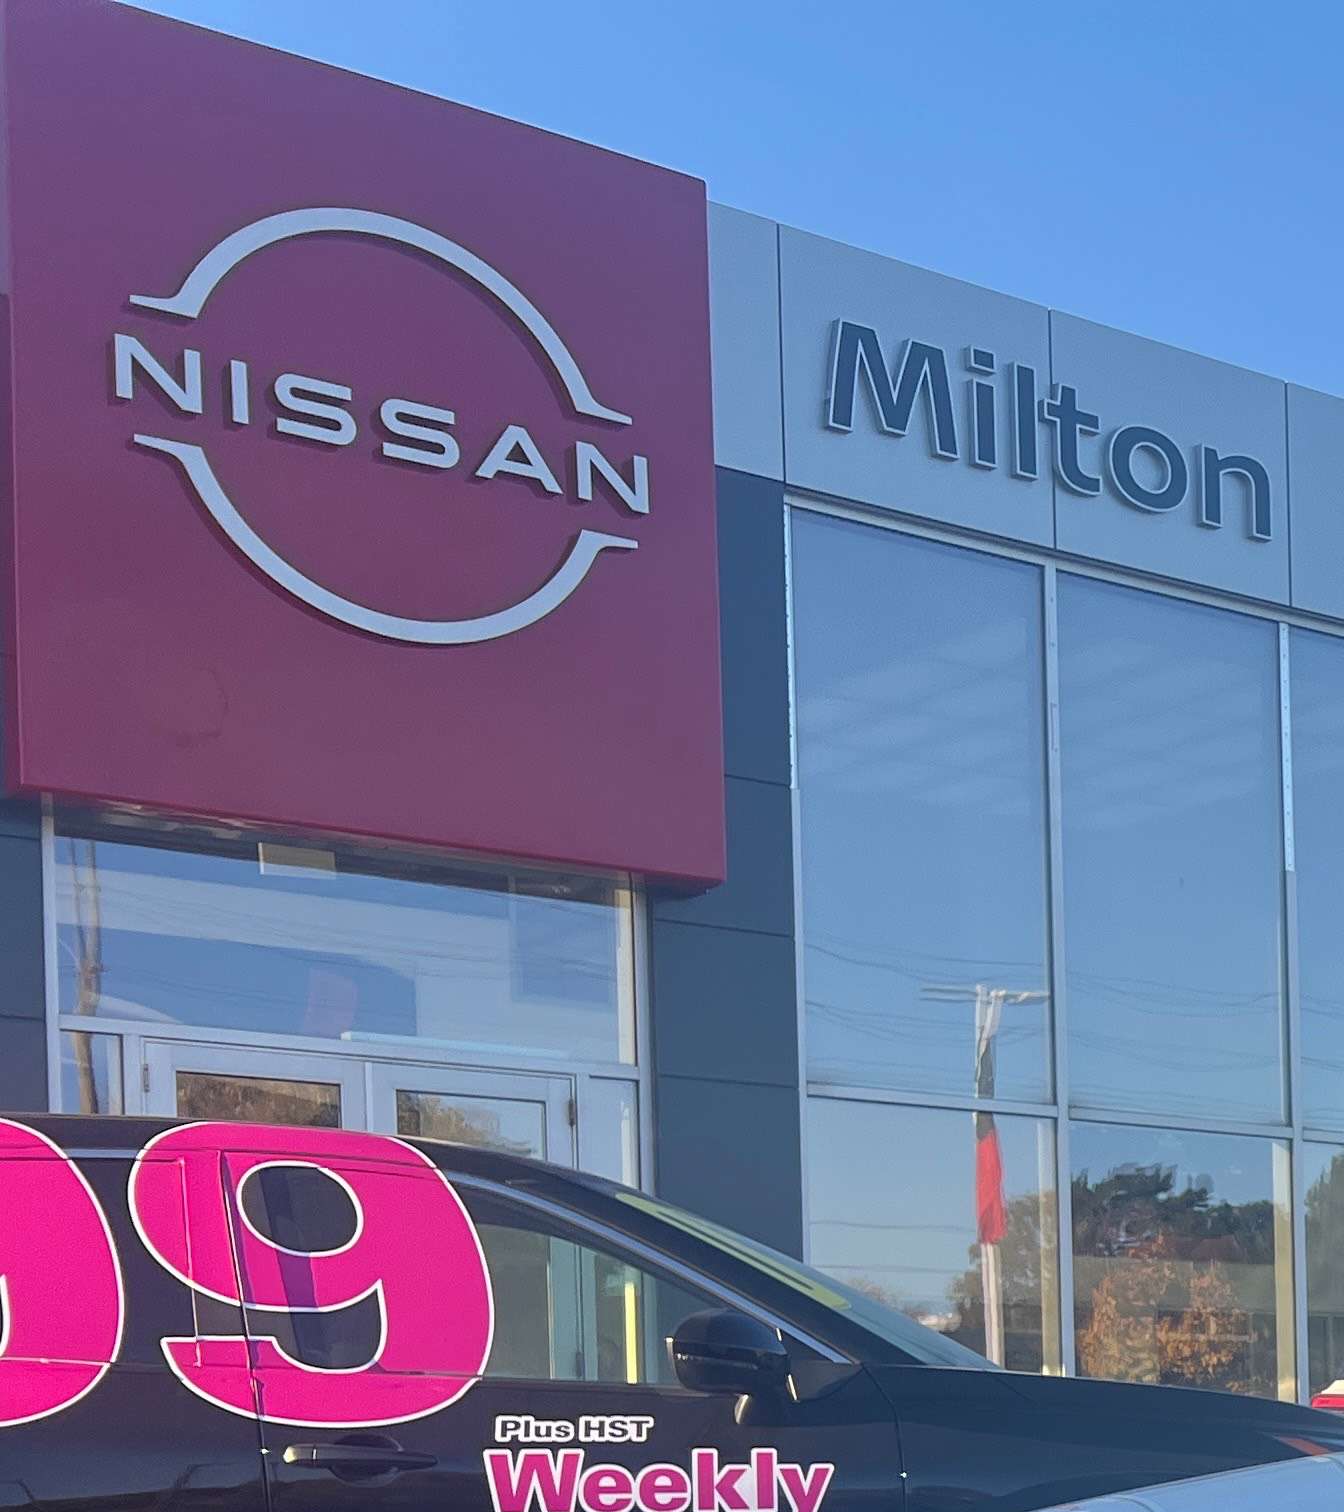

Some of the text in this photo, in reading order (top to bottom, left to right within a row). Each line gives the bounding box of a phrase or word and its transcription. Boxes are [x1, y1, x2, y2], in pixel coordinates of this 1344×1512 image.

[114, 333, 650, 513] NISSAN
[826, 317, 1272, 541] Milton
[496, 1407, 653, 1442] Plus HST
